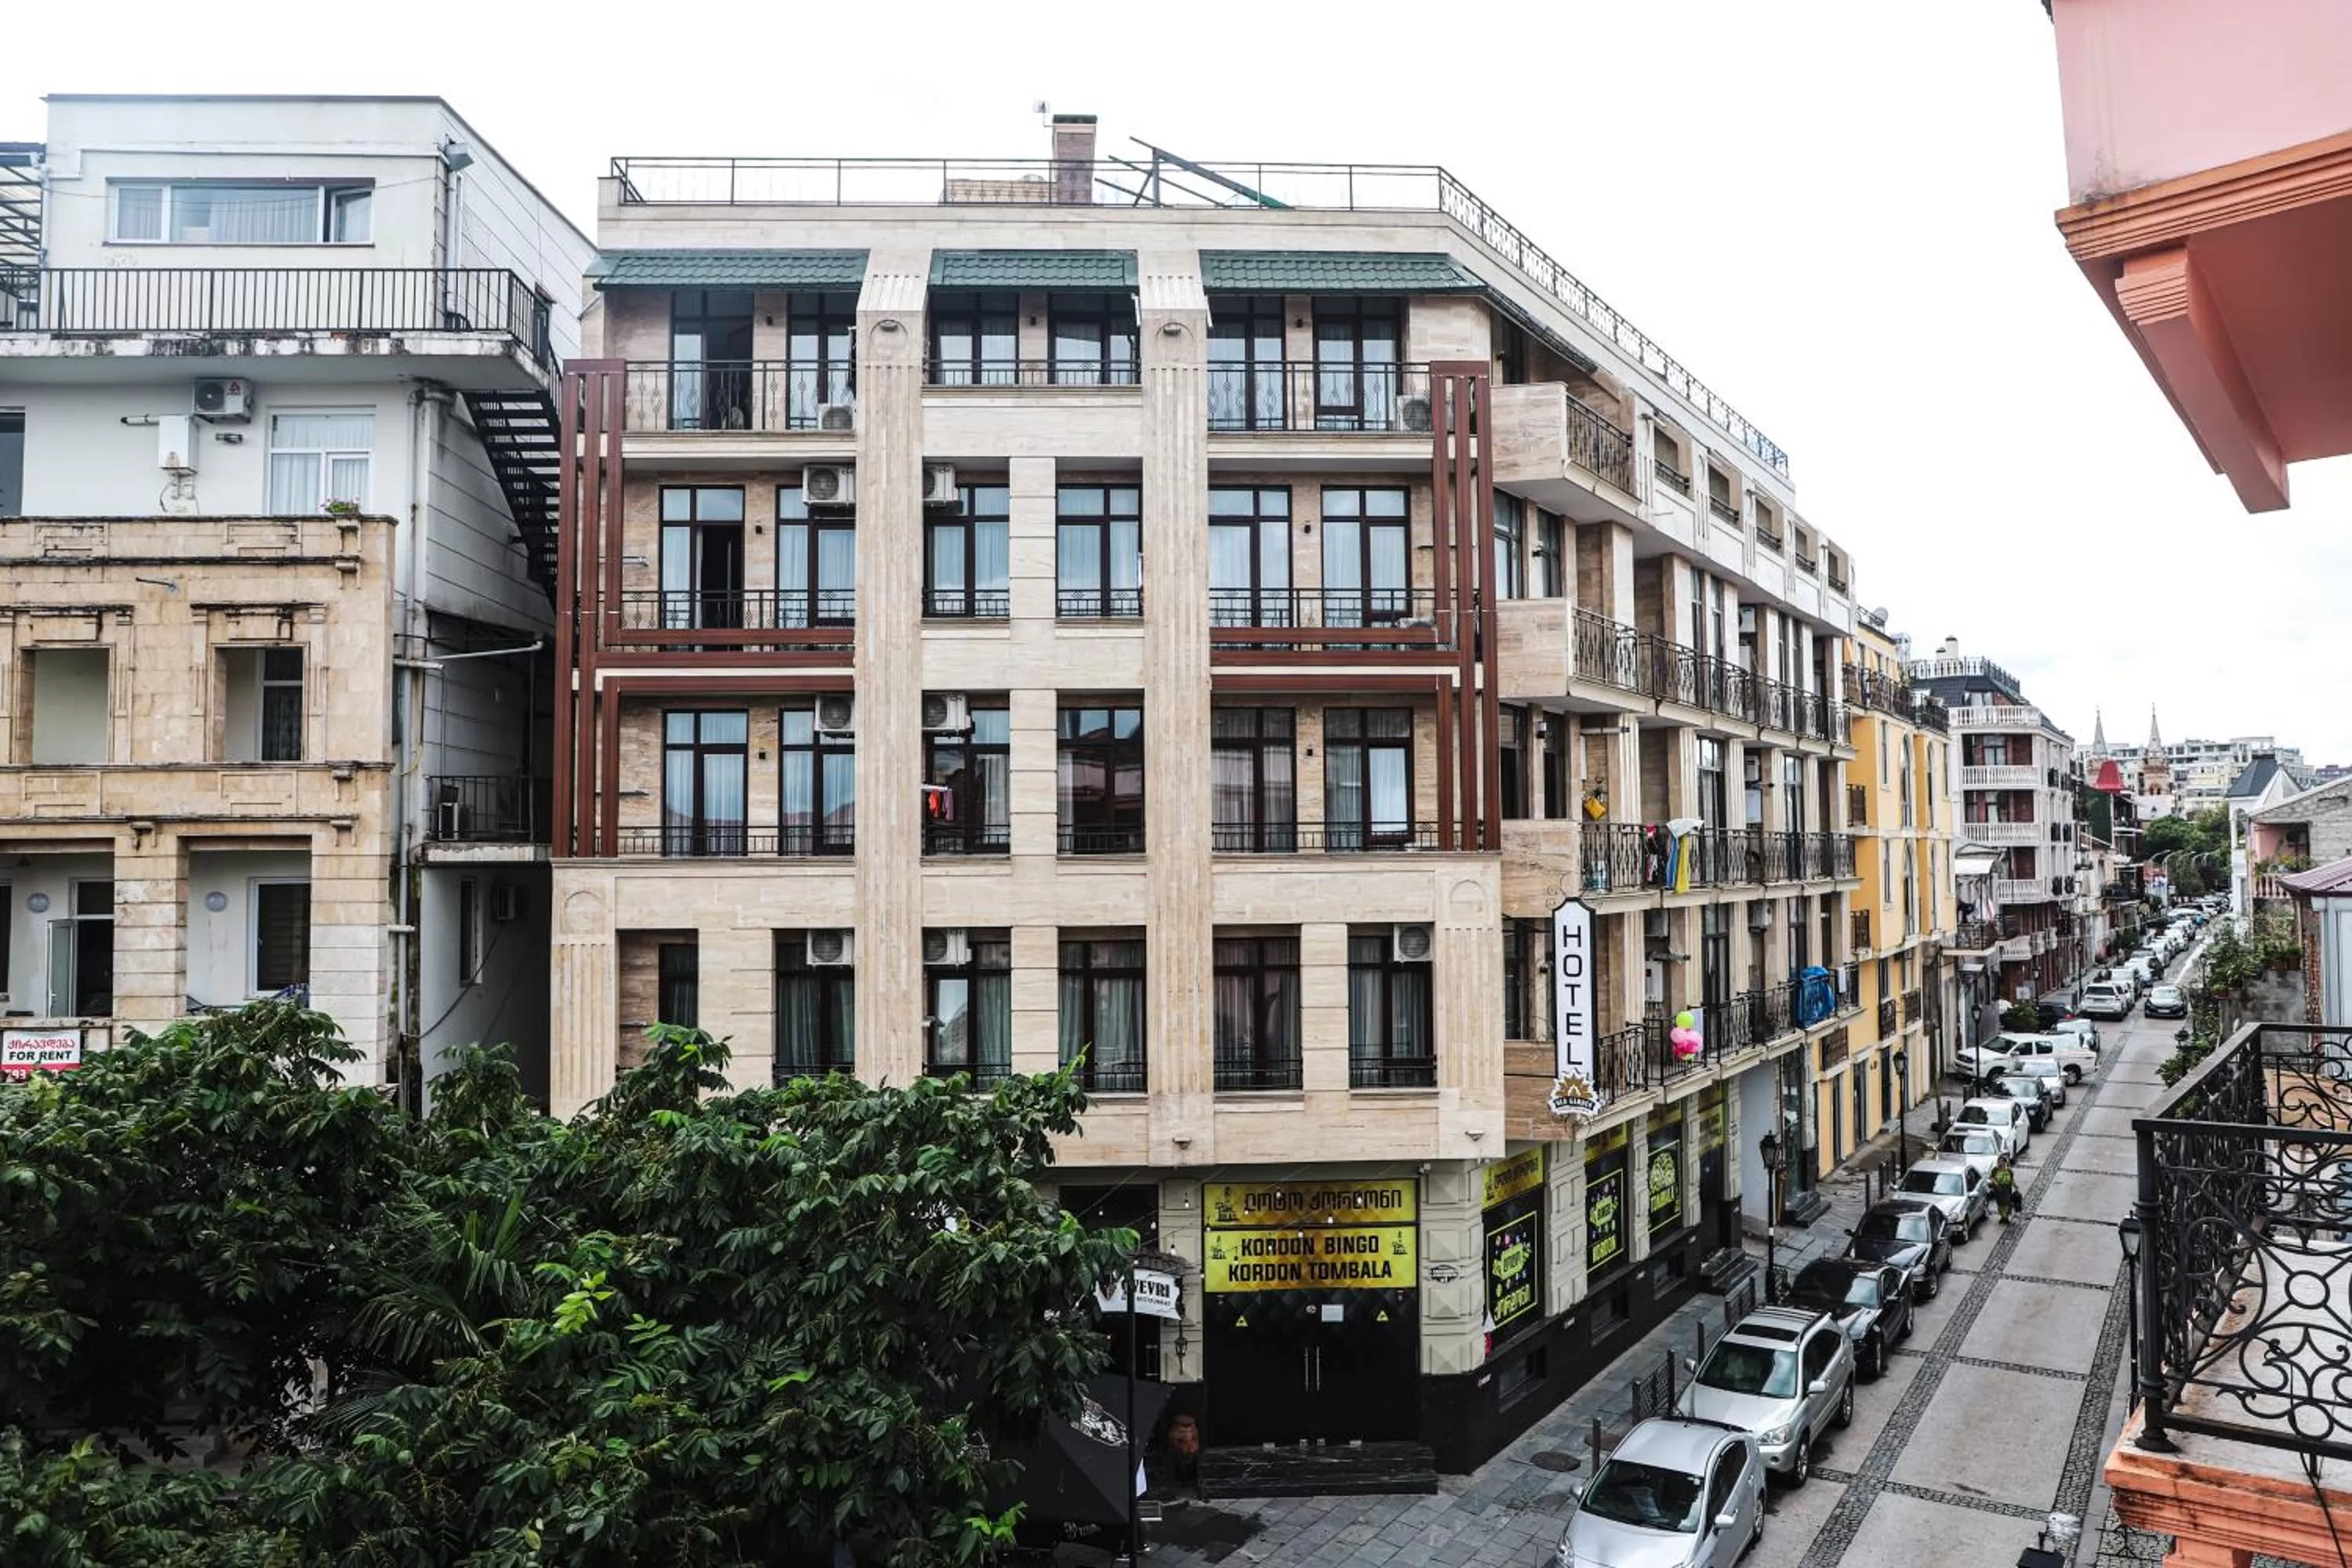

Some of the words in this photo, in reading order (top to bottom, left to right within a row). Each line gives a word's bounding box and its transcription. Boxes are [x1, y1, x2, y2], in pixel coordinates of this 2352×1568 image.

[1563, 924, 1583, 1065] HOTEL
[9, 1051, 35, 1061] FOR
[39, 1051, 72, 1061] RENT
[1241, 1236, 1315, 1257] KORDON
[1324, 1235, 1379, 1254] BINGO
[1229, 1263, 1301, 1282] KORDON
[1308, 1260, 1392, 1280] TOMBALA
